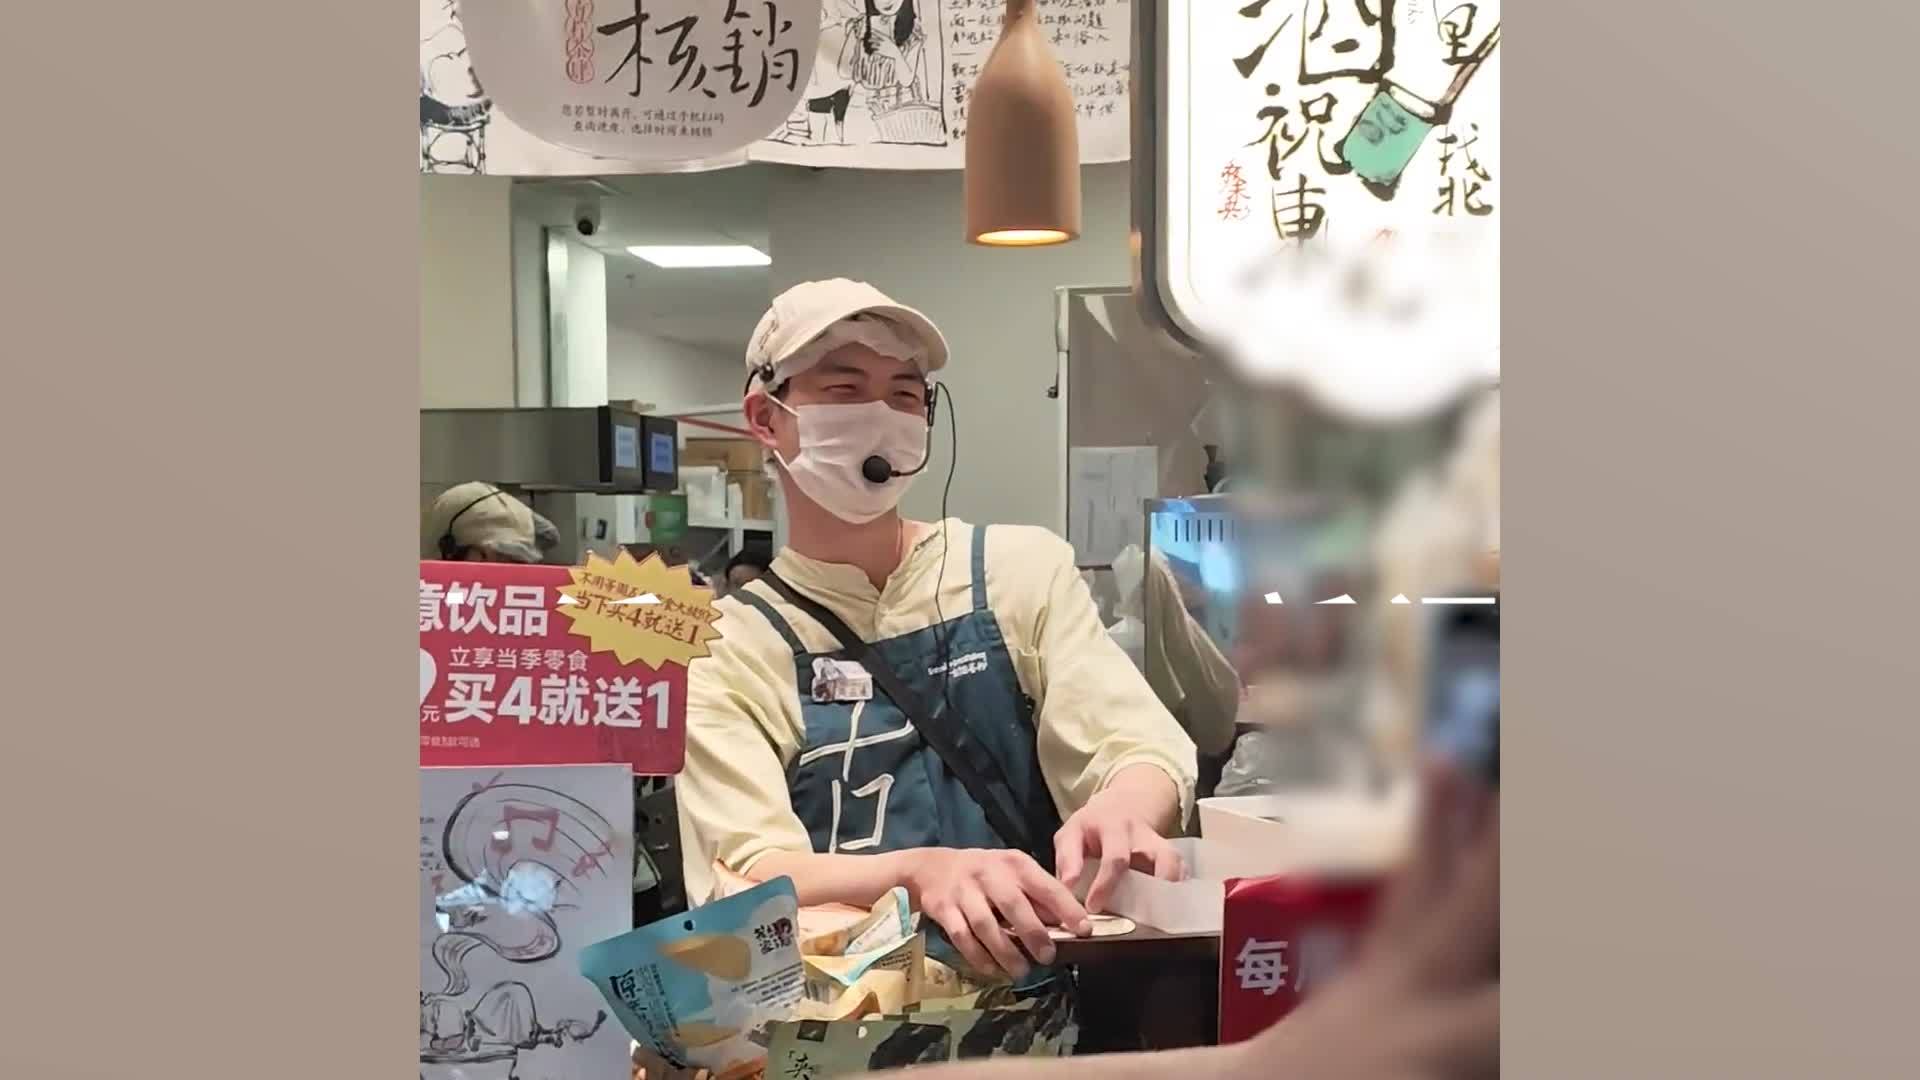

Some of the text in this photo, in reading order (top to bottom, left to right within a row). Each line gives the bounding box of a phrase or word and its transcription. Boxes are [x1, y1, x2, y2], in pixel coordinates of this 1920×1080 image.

[449, 646, 589, 673] 立享当季零食
[445, 673, 671, 730] 买4就送1
